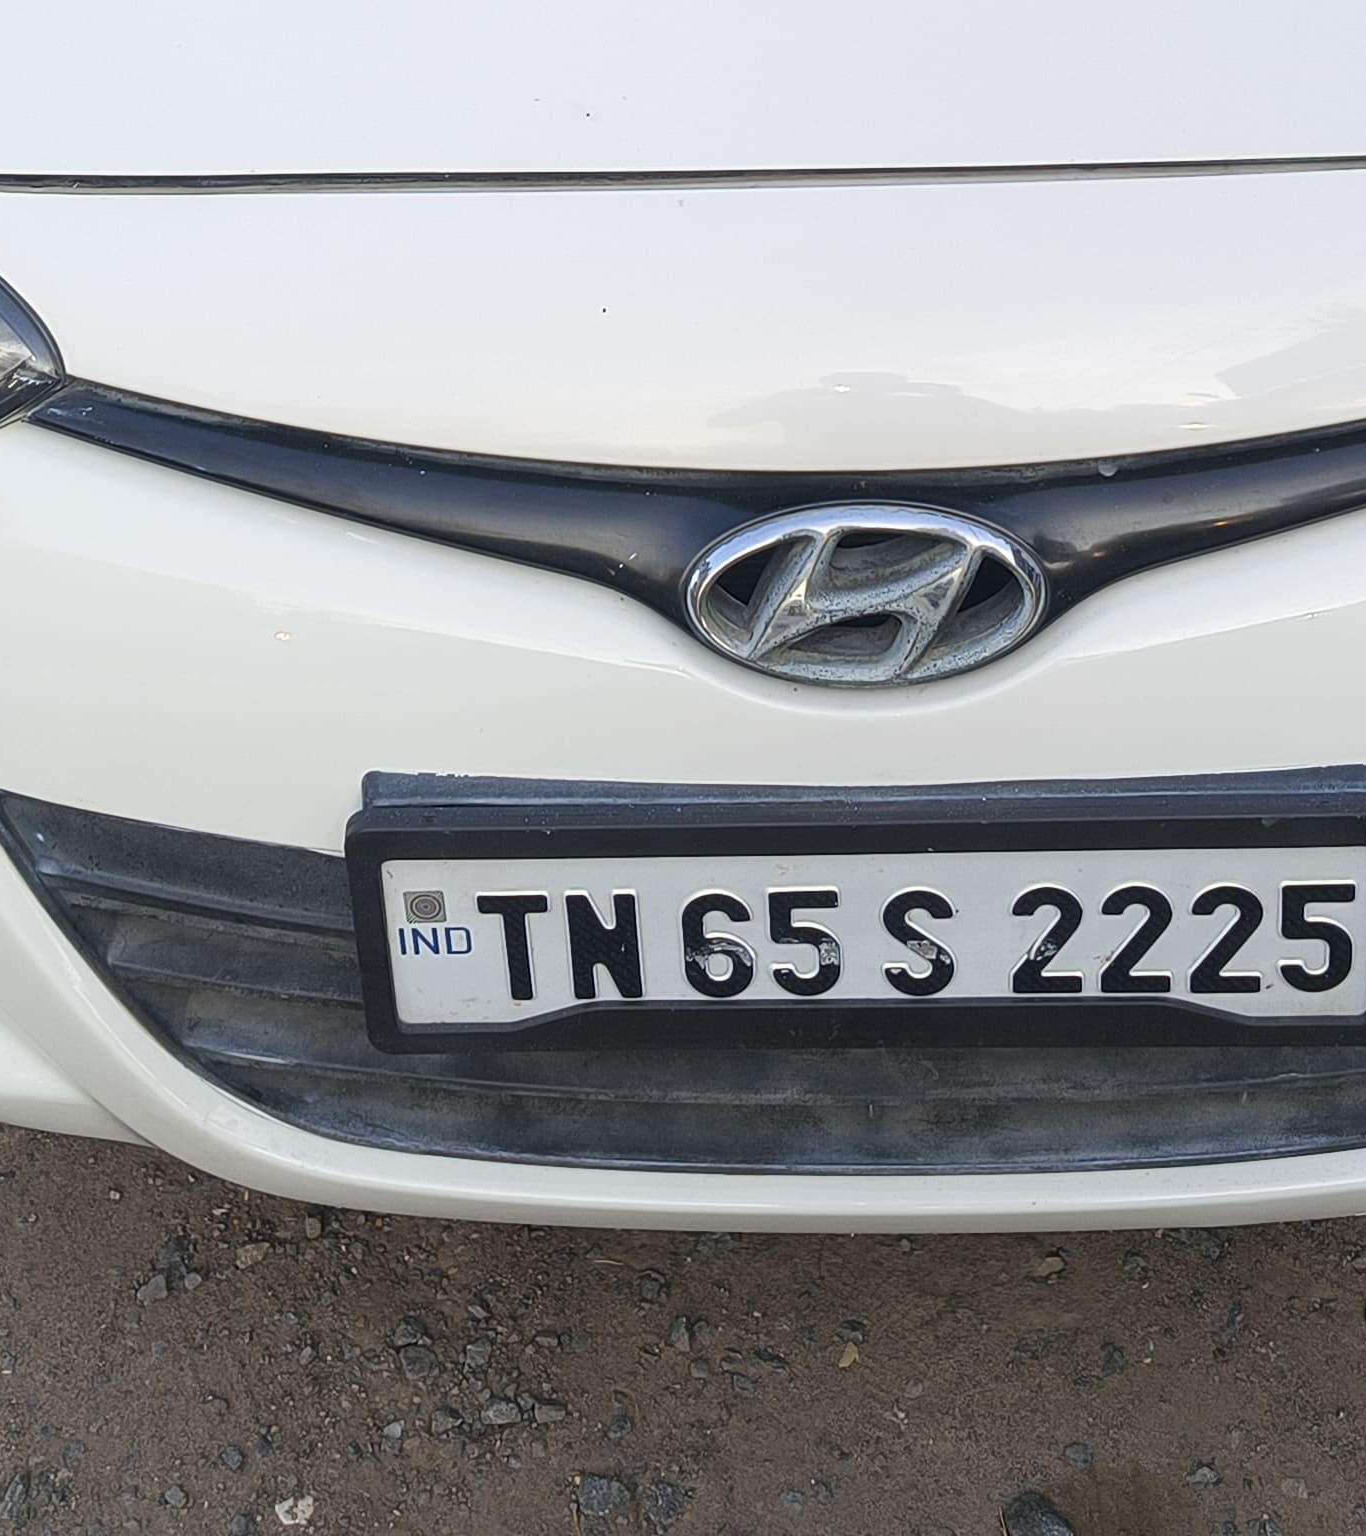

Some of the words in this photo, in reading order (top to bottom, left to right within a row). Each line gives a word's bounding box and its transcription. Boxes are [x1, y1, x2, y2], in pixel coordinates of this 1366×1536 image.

[398, 926, 473, 956] IND
[476, 893, 644, 1001] TN
[681, 890, 841, 999] 65
[882, 887, 955, 997] S
[1010, 883, 1357, 994] 2225
